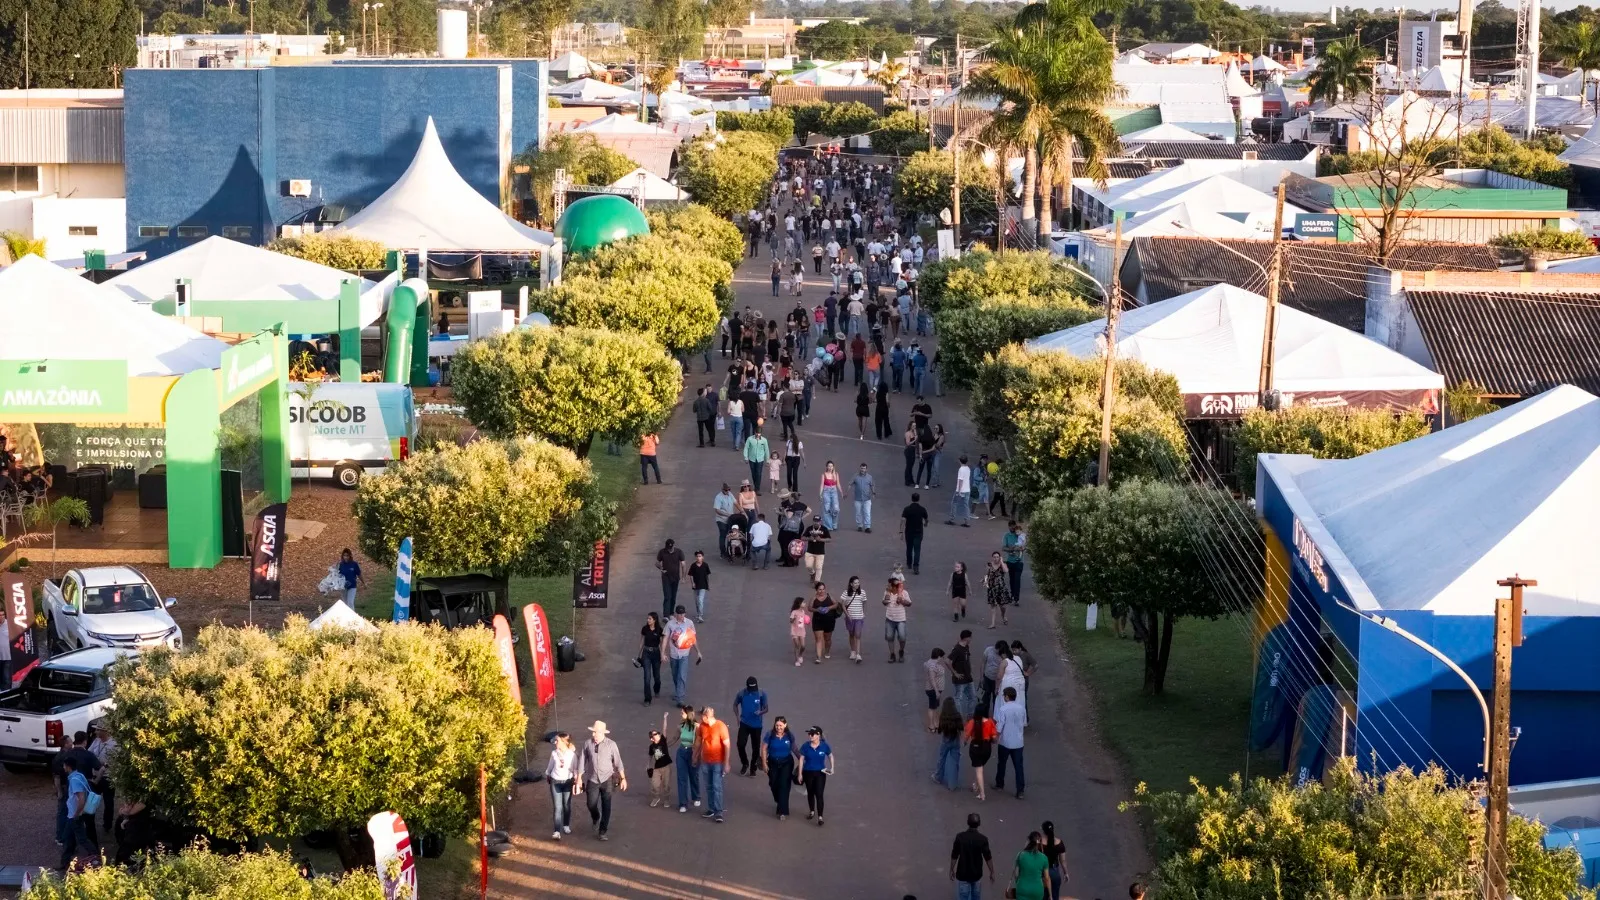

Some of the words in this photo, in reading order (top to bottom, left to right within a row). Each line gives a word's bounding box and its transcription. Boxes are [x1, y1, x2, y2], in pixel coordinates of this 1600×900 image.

[2, 385, 102, 406] AMAZÔNIA
[289, 406, 366, 423] SICOOB
[314, 424, 346, 435] Norte
[349, 425, 366, 434] MT
[76, 437, 83, 445] A
[86, 437, 121, 447] FORÇA
[125, 438, 146, 447] QUE
[76, 449, 83, 457] E
[87, 449, 152, 458] IMPULSIONA
[155, 450, 163, 458] O
[260, 514, 277, 558] ASCIA
[581, 562, 593, 586] ALL
[12, 582, 28, 629] ASCIA
[588, 592, 606, 600] ASCIA
[532, 610, 546, 653] ASCIA
